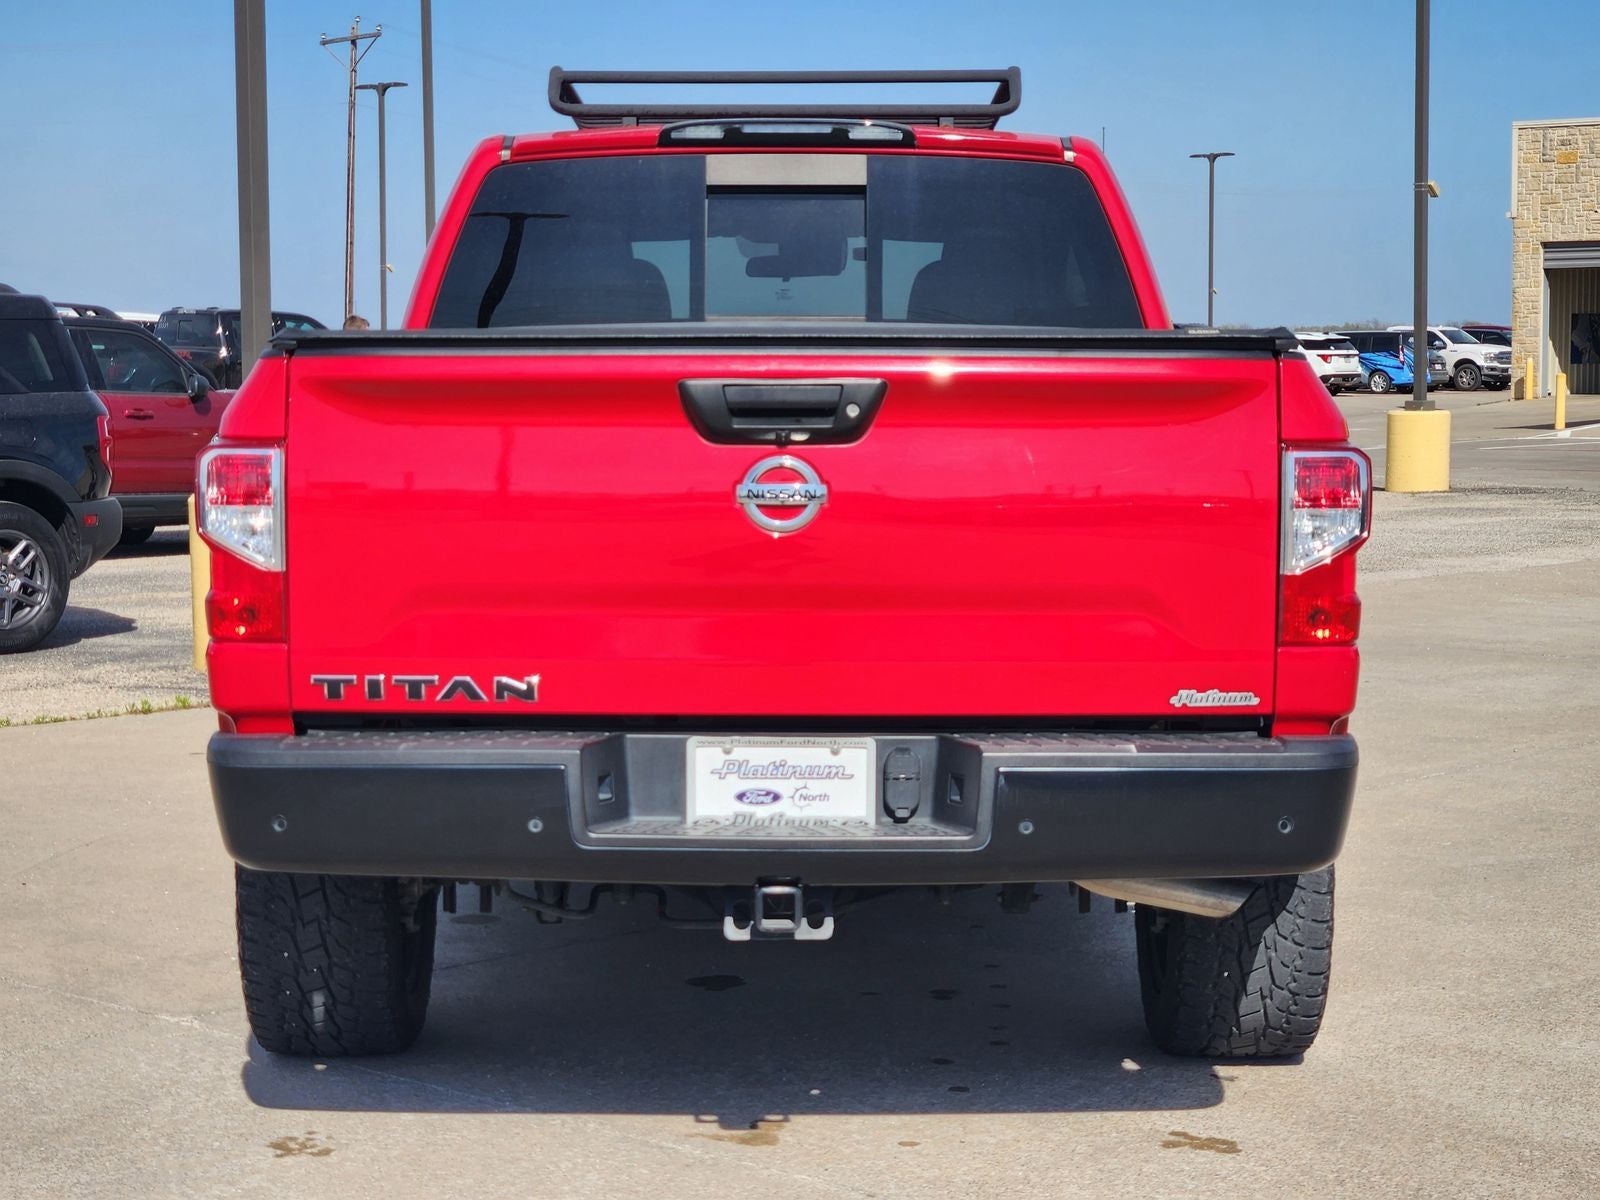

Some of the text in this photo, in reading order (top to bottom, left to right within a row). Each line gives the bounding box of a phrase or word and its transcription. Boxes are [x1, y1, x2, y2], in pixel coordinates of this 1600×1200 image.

[747, 488, 817, 499] NISSAN
[310, 674, 541, 702] TITAN
[1169, 689, 1260, 708] Platinum
[710, 759, 855, 780] Platinum
[738, 789, 778, 804] Ford
[799, 793, 830, 803] North
